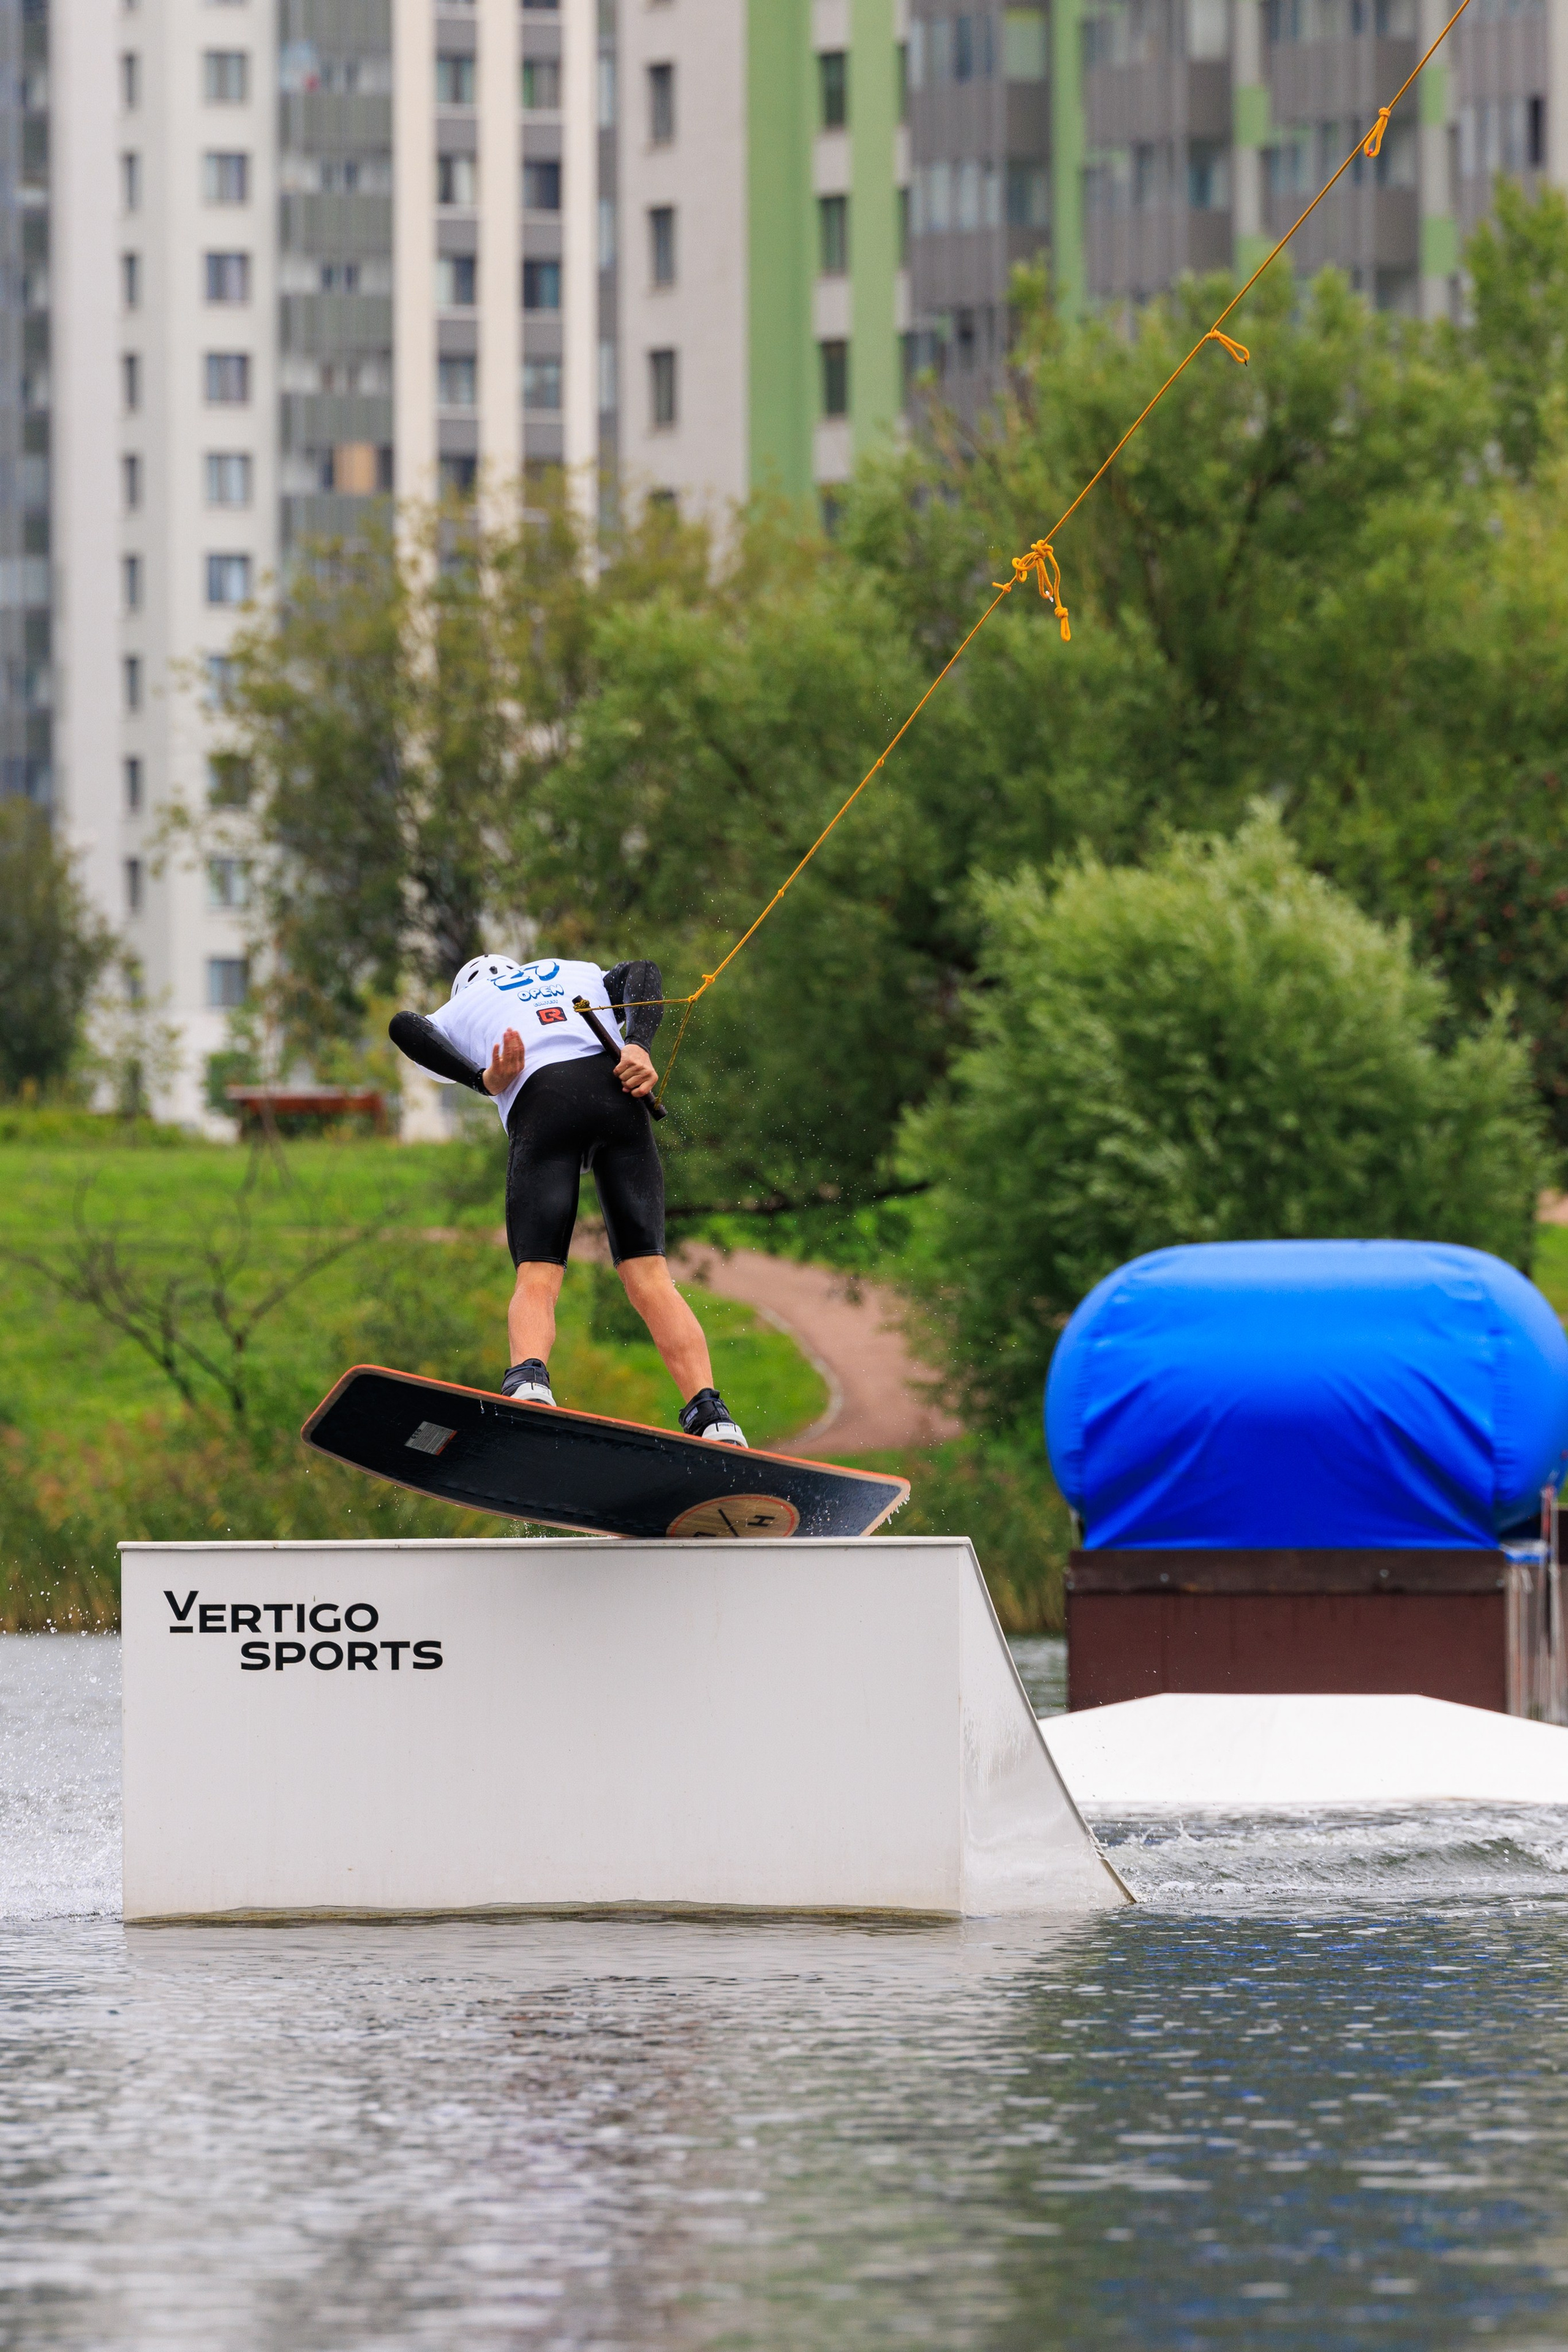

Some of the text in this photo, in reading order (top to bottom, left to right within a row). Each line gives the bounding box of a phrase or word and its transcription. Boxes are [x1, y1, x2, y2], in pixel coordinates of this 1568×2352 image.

[518, 984, 564, 1001] OPEN
[163, 1591, 379, 1634] VERTIGO
[240, 1640, 443, 1671] SPORTS
